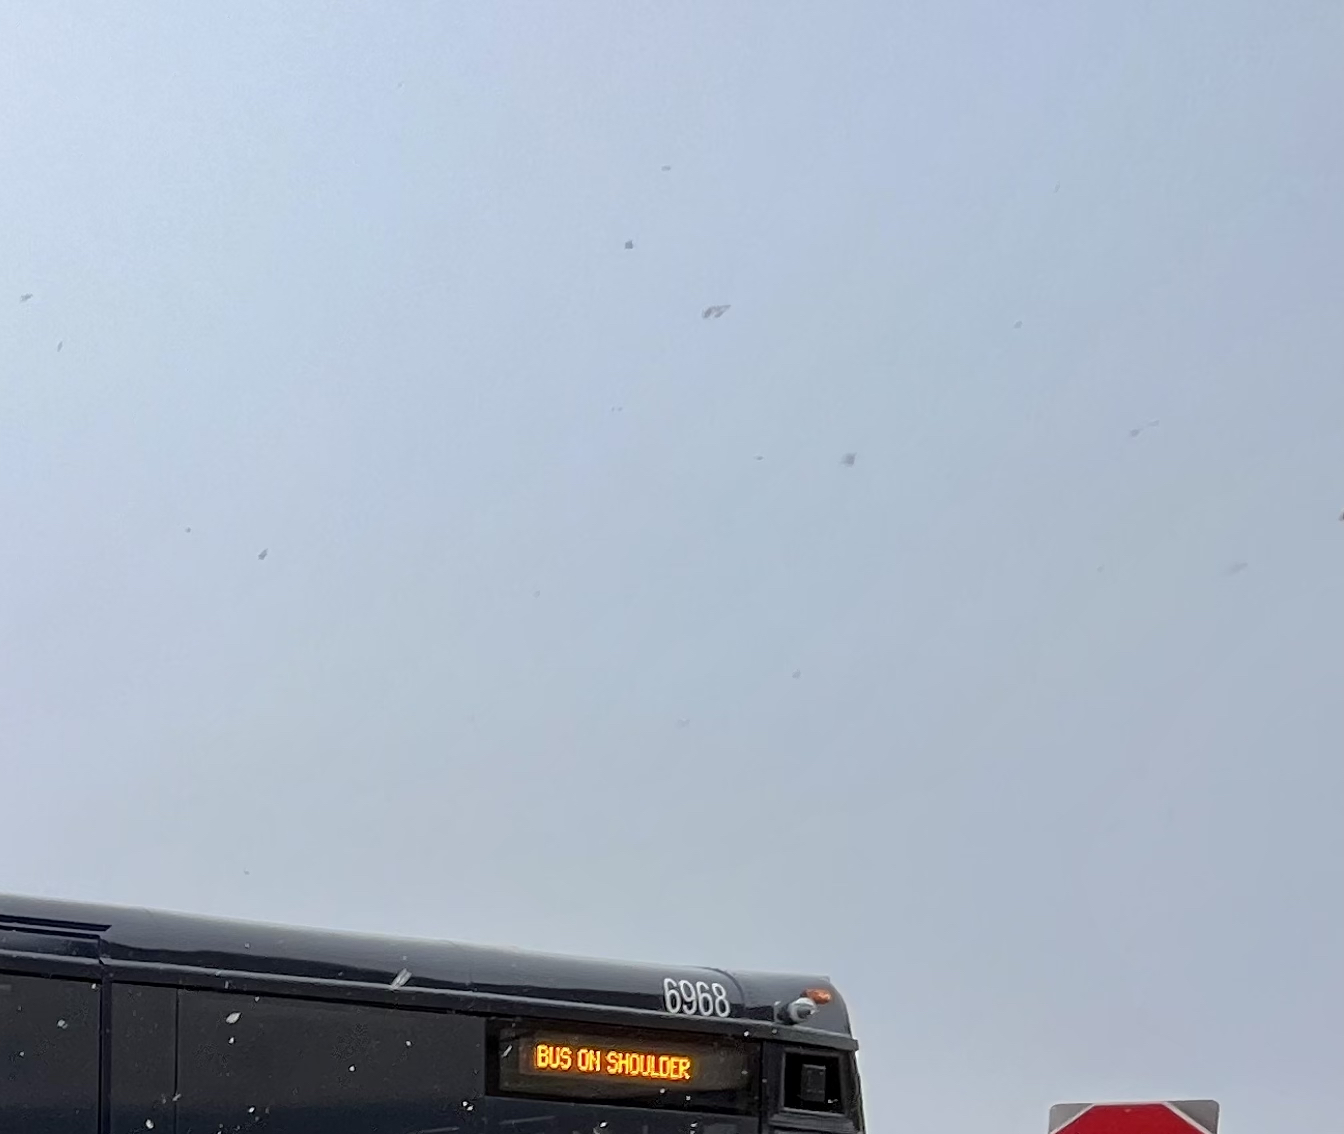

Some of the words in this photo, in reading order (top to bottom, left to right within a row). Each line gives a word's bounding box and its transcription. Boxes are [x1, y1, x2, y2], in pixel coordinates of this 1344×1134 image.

[663, 977, 730, 1018] 6968
[536, 1044, 572, 1070] BUS
[576, 1048, 601, 1072] ON
[605, 1051, 691, 1080] SHOULDER
